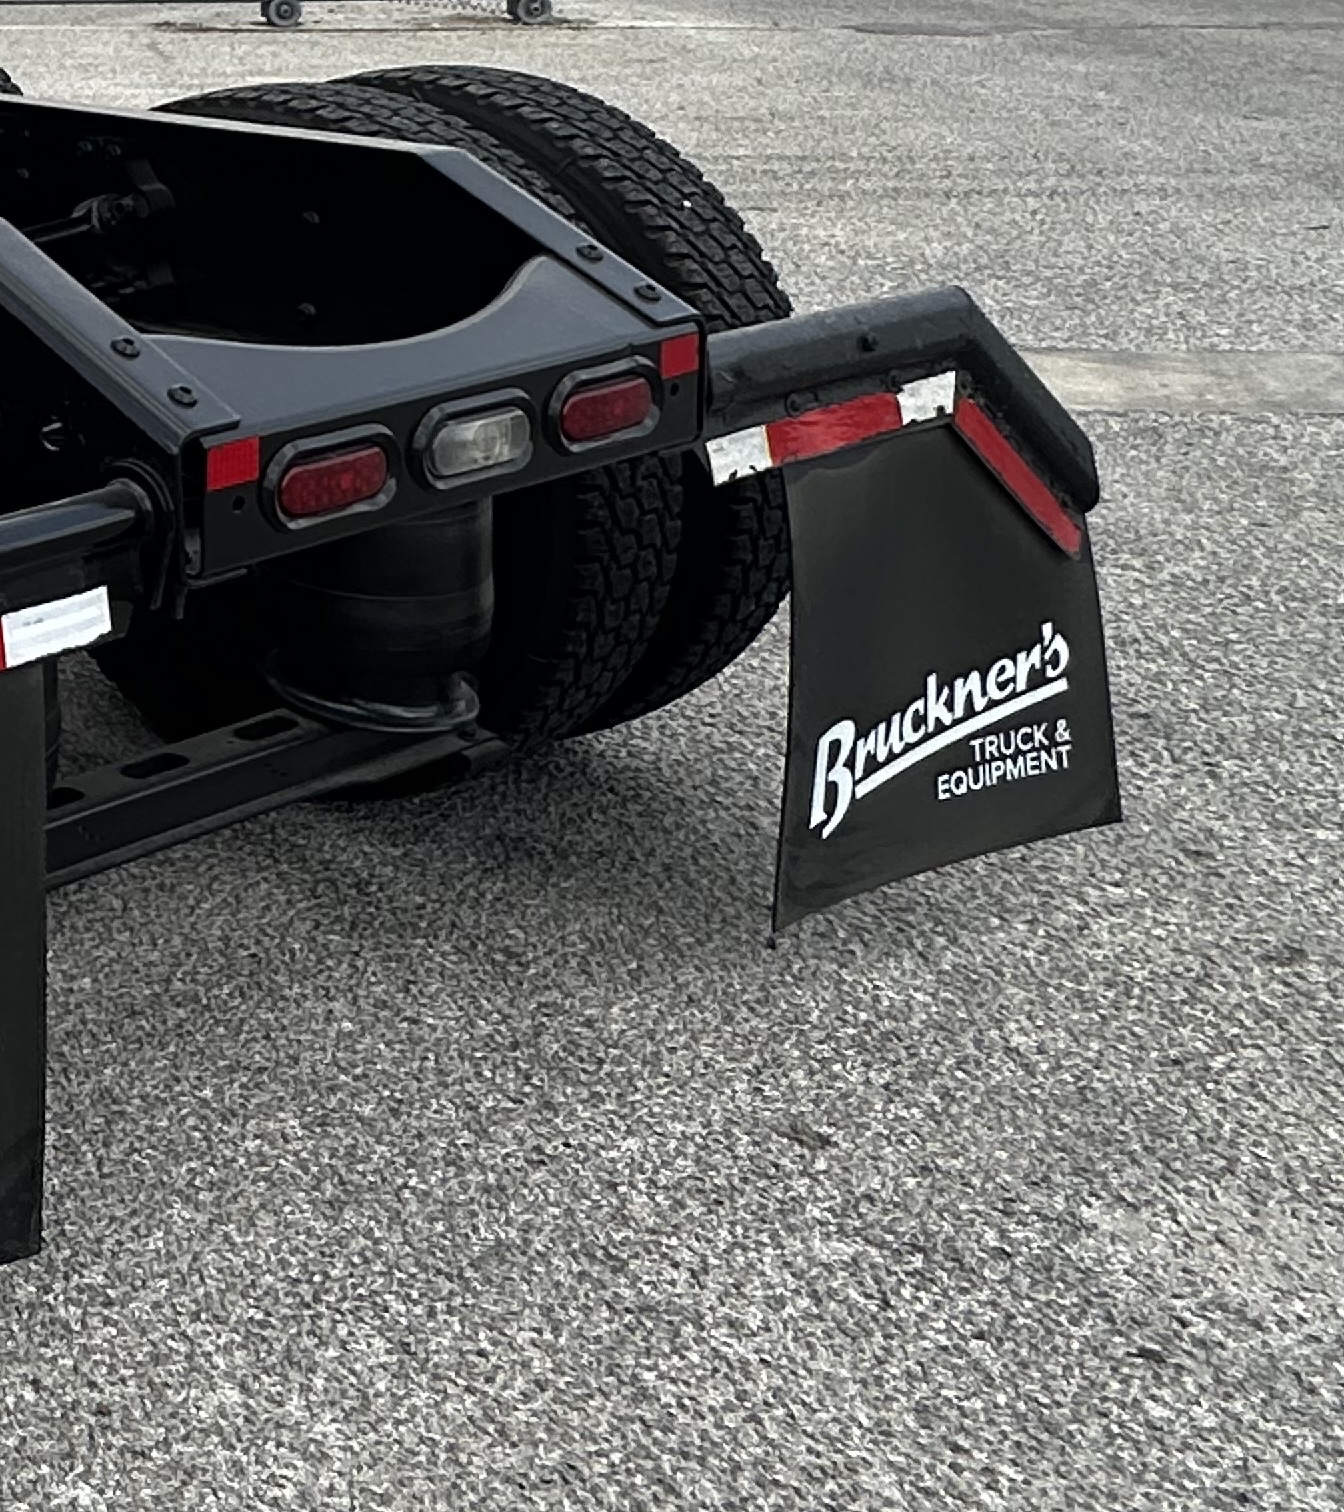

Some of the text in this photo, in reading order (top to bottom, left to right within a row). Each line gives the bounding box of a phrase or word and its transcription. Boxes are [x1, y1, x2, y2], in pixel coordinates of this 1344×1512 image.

[809, 622, 1070, 840] Bruckner's
[968, 718, 1072, 763] TRUCK &
[937, 745, 1072, 800] EQUIPMENT
